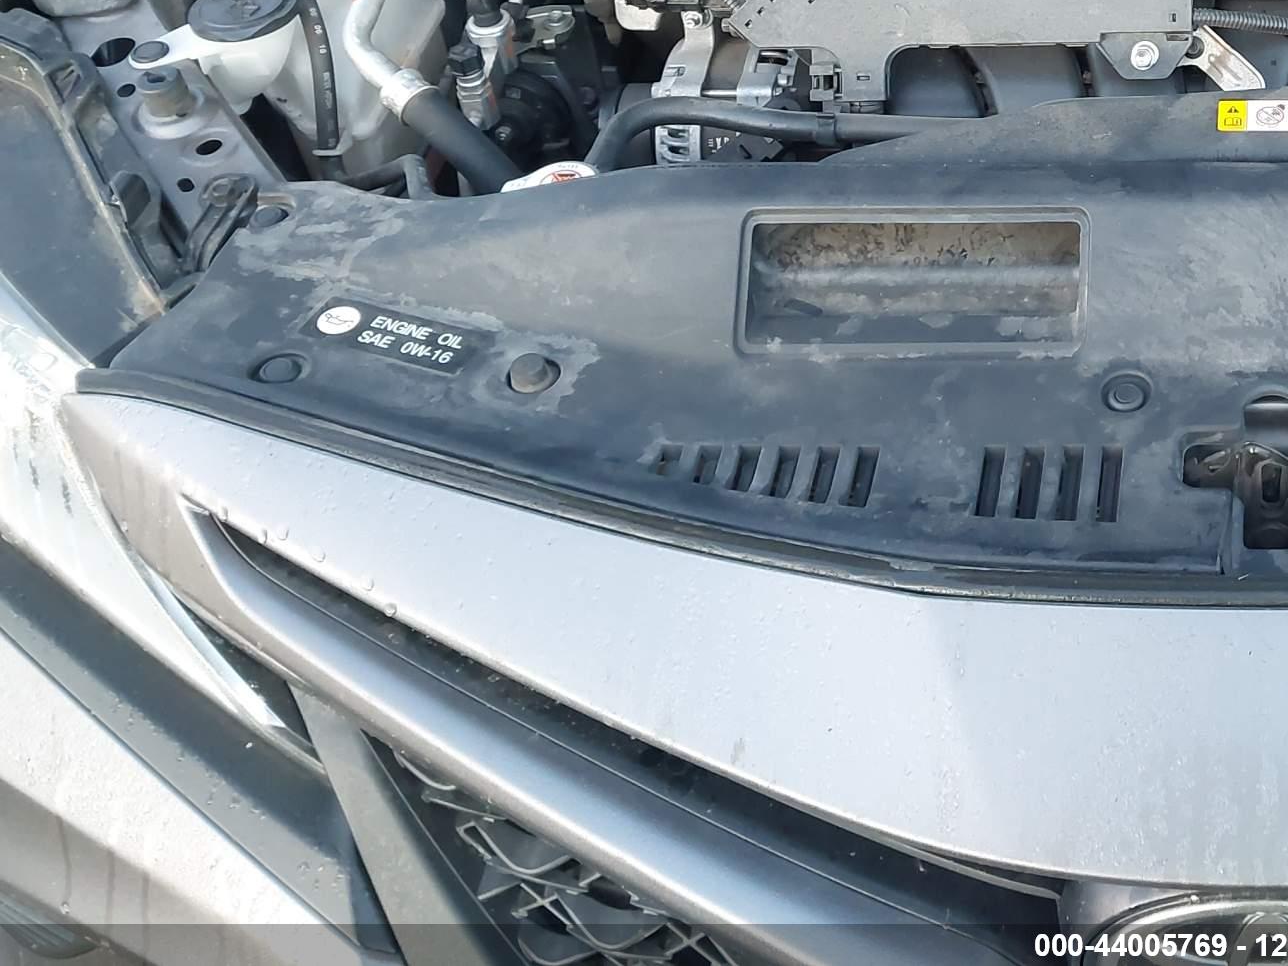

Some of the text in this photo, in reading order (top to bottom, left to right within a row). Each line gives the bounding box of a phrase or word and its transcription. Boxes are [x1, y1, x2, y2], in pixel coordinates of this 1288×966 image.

[357, 330, 453, 364] SAE 0W-16
[370, 316, 464, 349] ENGINE OIL
